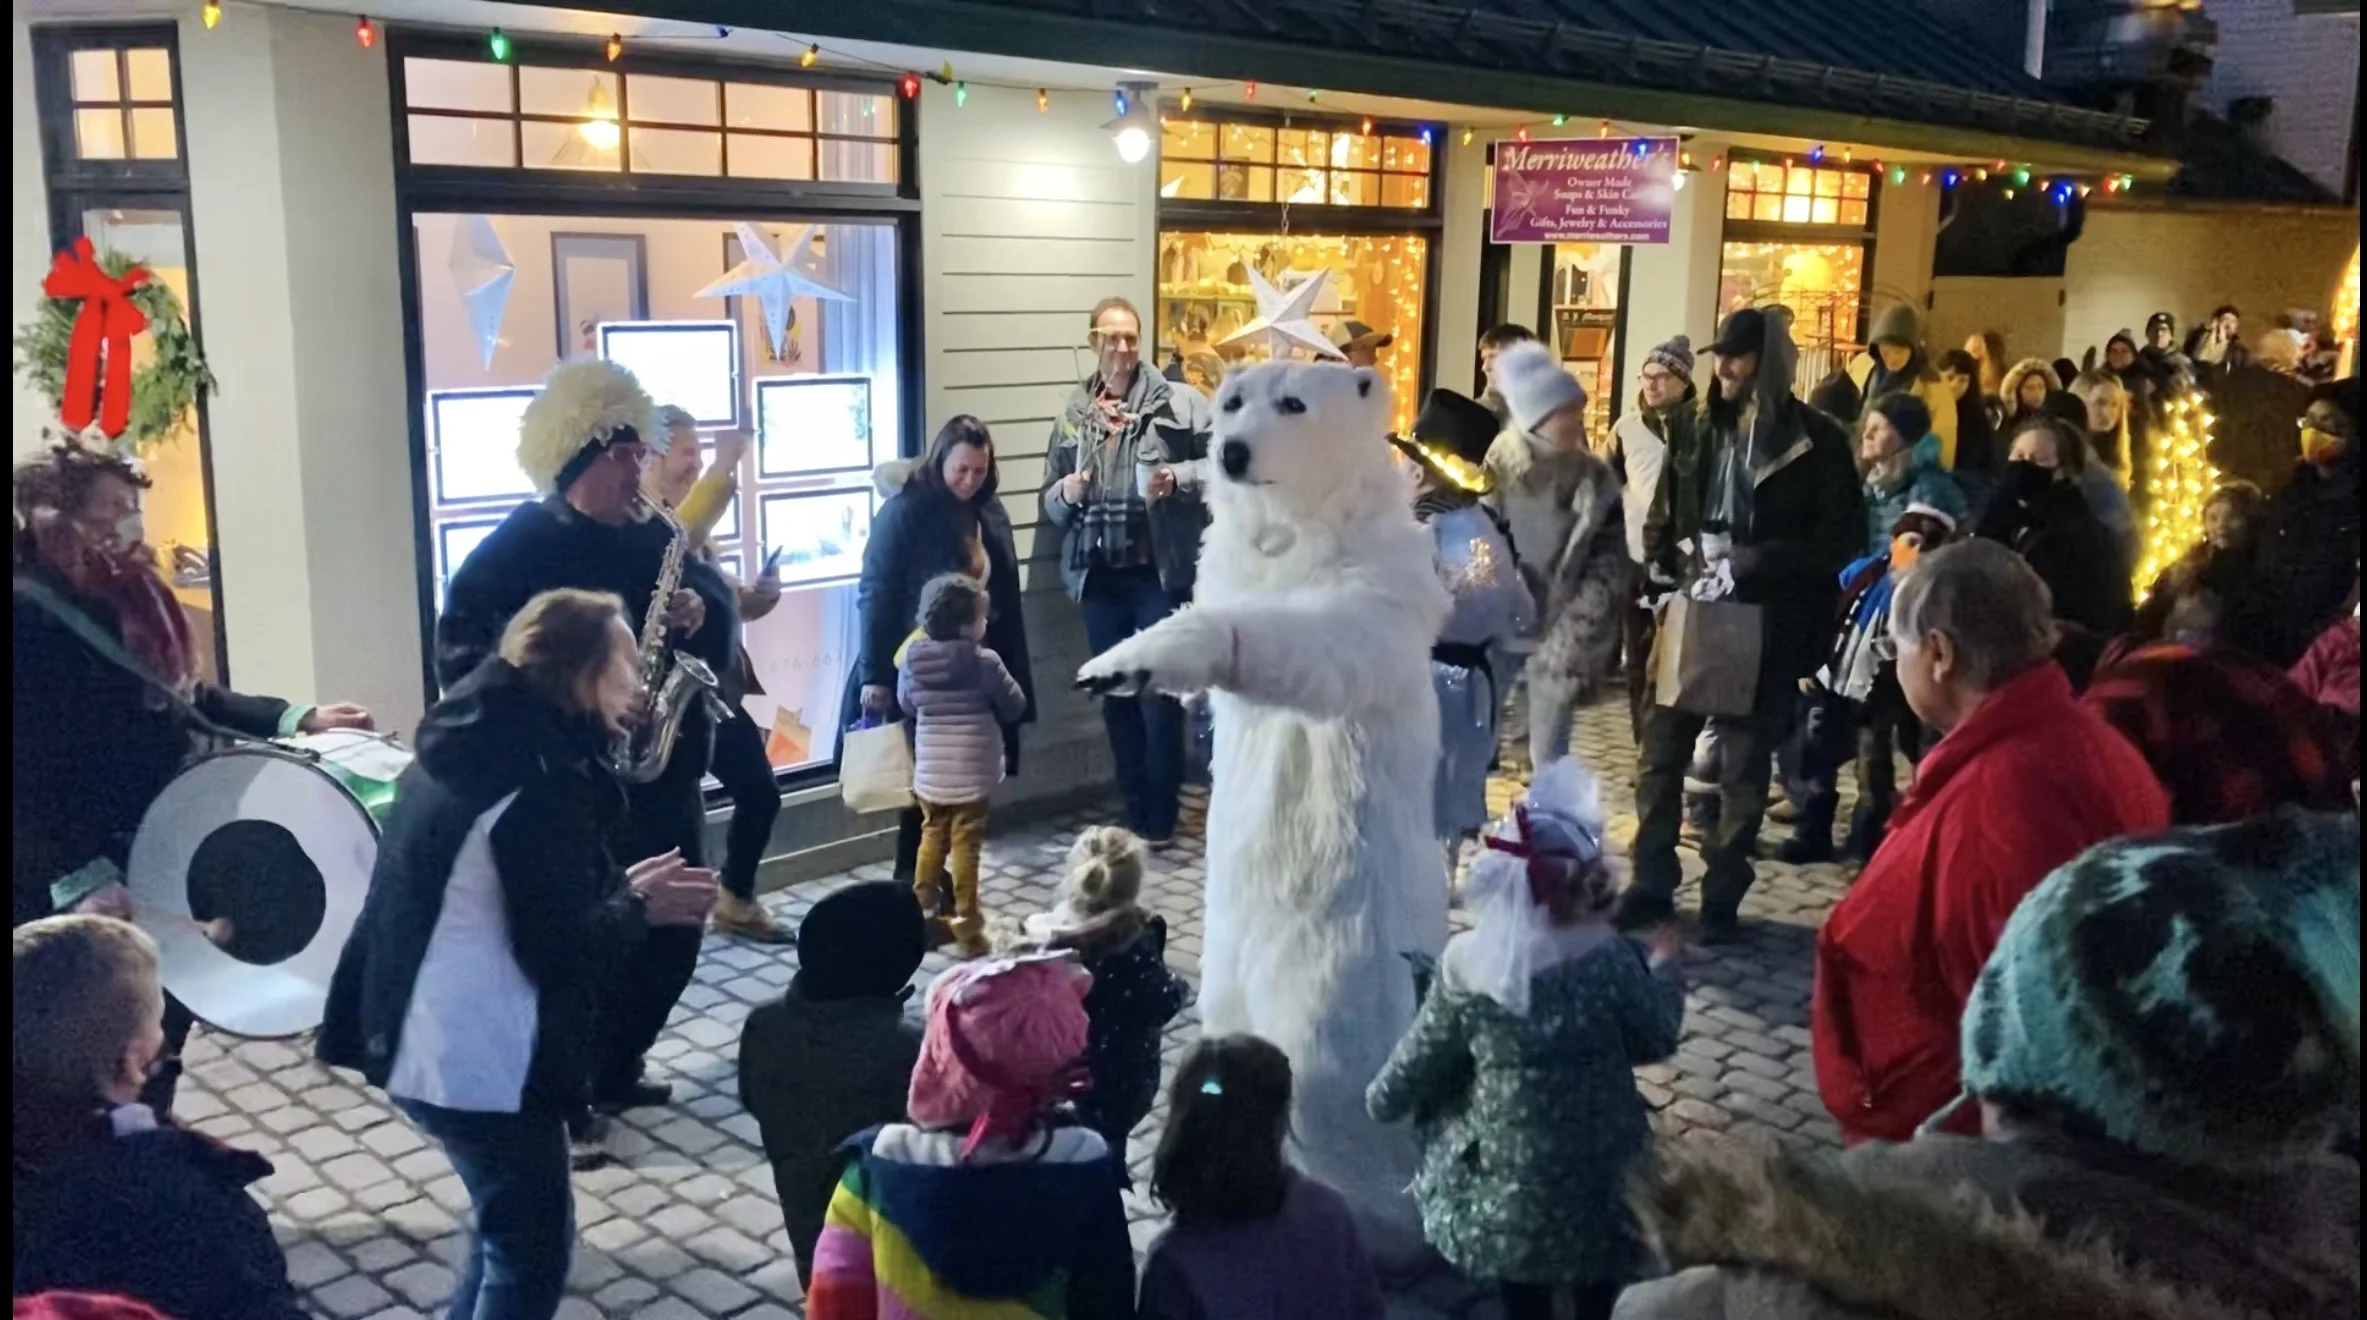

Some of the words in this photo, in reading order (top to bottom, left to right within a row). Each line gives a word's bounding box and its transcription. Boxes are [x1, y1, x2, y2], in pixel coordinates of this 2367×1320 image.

[1567, 177, 1602, 188] Owner
[1604, 176, 1632, 187] Made
[1554, 190, 1582, 201] Soaps
[1584, 190, 1595, 199] &
[1597, 189, 1620, 199] Skin
[1565, 206, 1584, 216] Fun
[1586, 205, 1597, 215] &
[1600, 205, 1630, 219] Funky
[1530, 218, 1556, 229] Gifts,
[1559, 218, 1595, 230] Jewelry
[1598, 218, 1608, 228] &
[1609, 218, 1668, 229] Accessories
